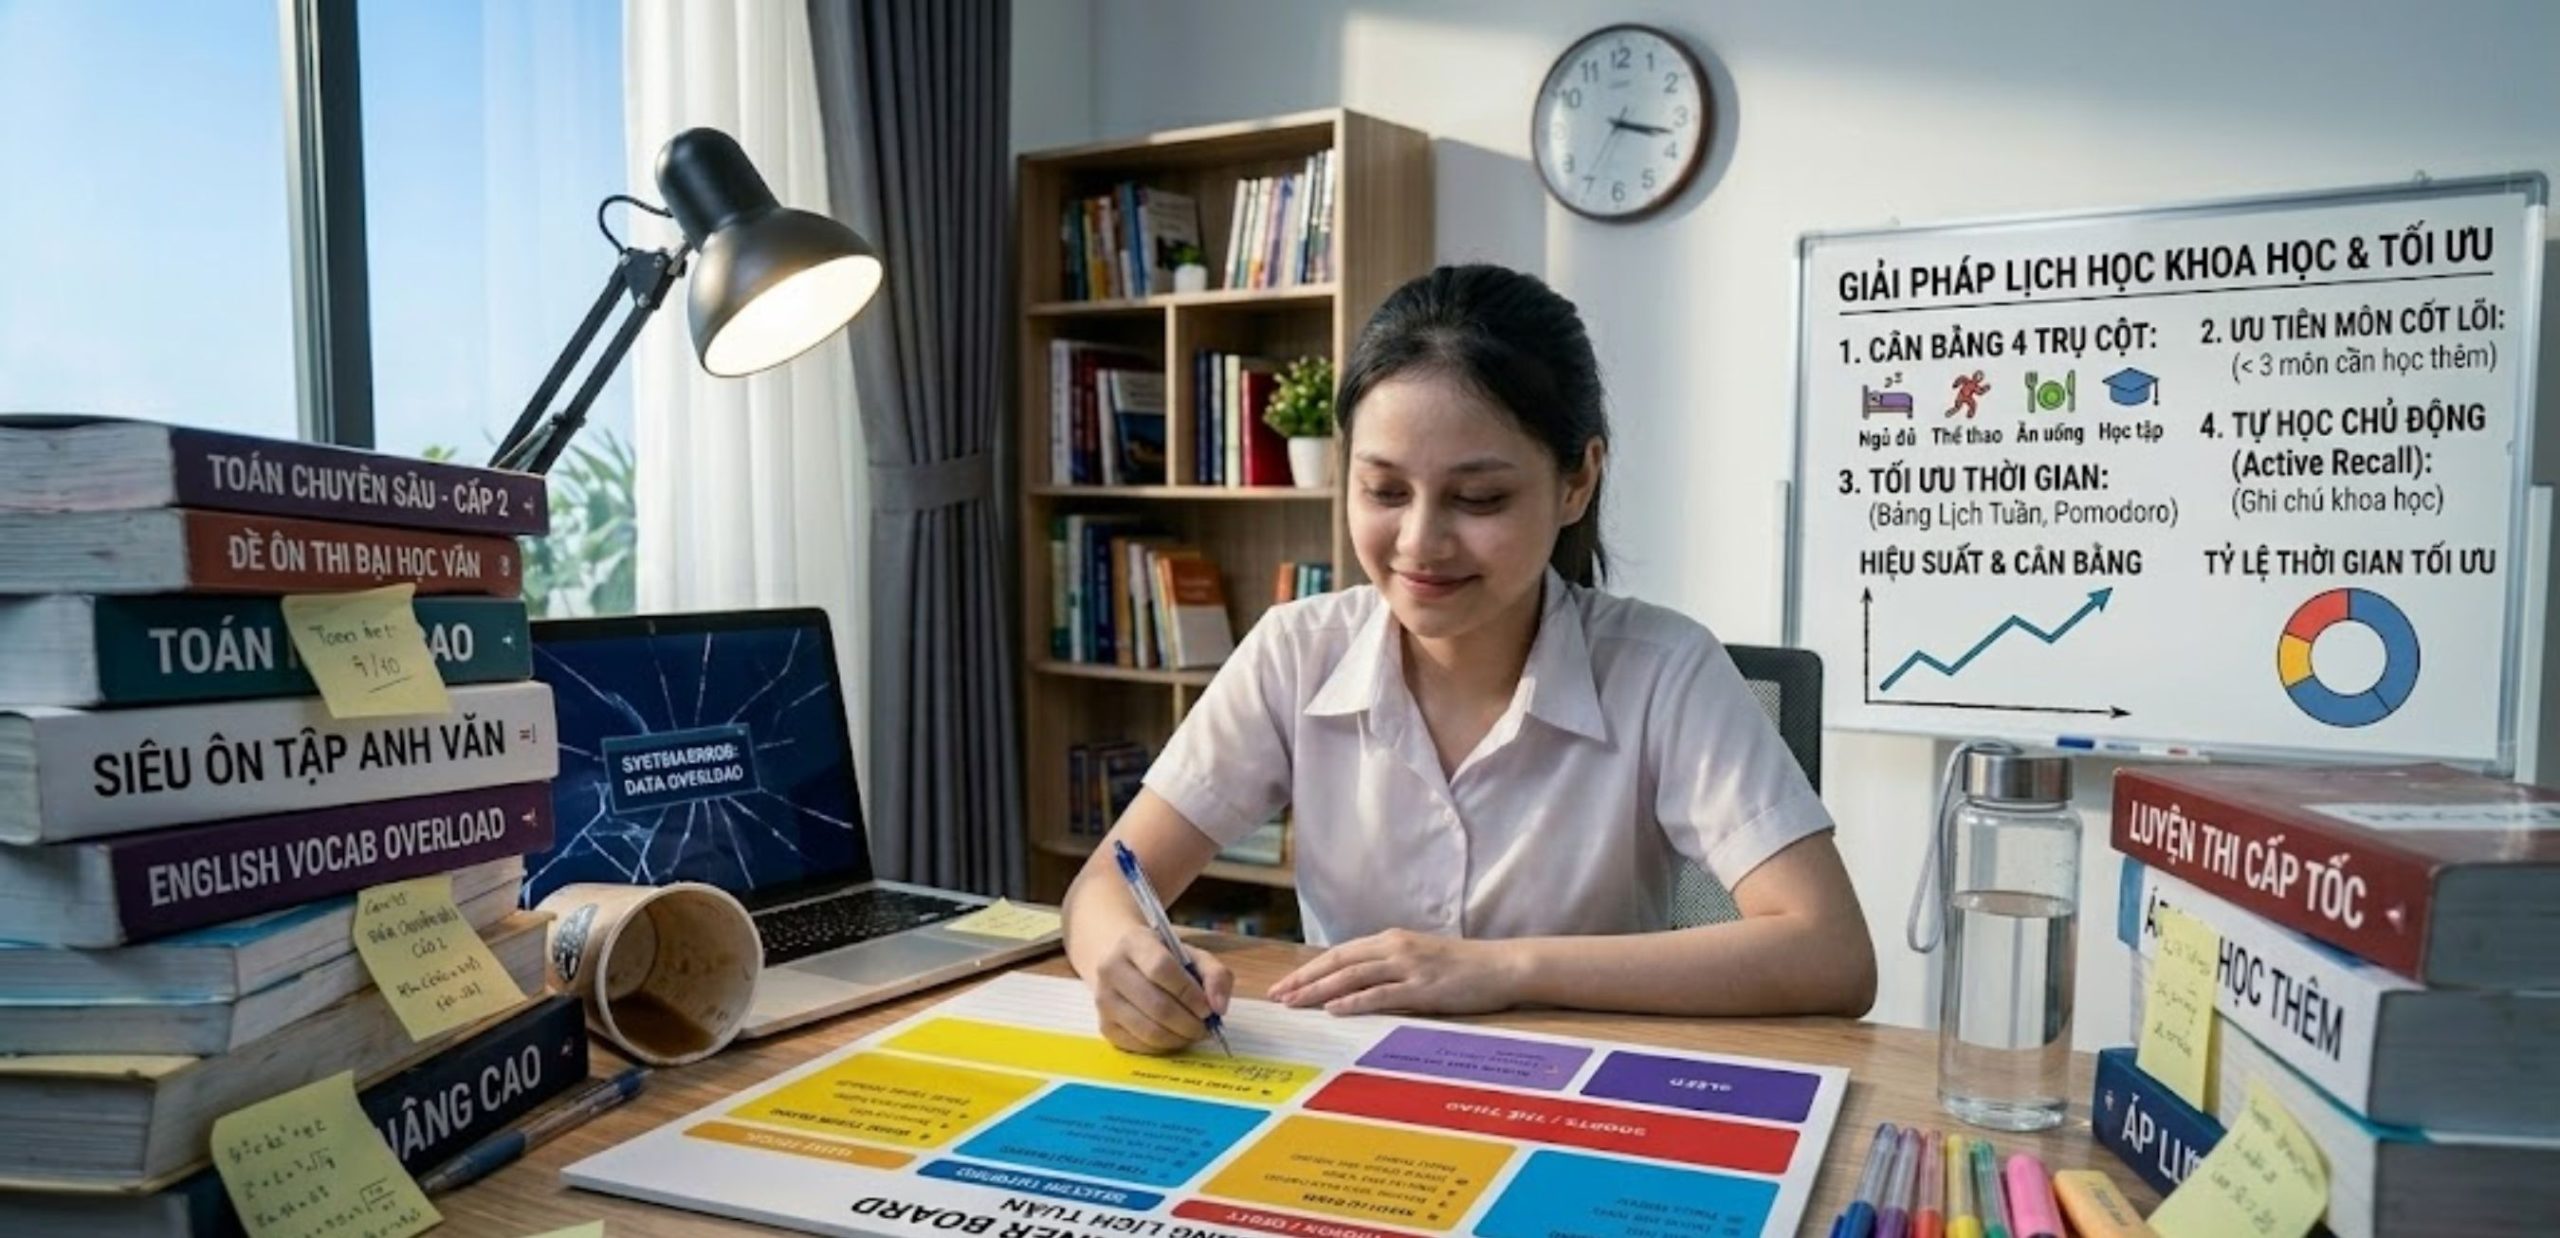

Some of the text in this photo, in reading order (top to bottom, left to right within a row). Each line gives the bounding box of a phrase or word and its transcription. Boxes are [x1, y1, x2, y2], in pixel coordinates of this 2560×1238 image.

[1581, 60, 1599, 83] 11
[1610, 48, 1631, 69] 12
[1646, 51, 1655, 71] 1
[1664, 72, 1679, 94] 2
[1674, 106, 1688, 128] 3
[1663, 141, 1678, 159] 4
[1582, 176, 1596, 194] 7
[1612, 181, 1625, 201] 6
[1641, 169, 1655, 189] 5
[1838, 220, 2494, 302] GIẢI PHÁP LỊCH HỌC KHOA HỌC & TỐI ƯU
[2201, 319, 2222, 344] 2.
[2230, 315, 2264, 342] ƯU
[2271, 307, 2326, 340] TIÊN
[2335, 304, 2393, 338] MÔN
[2401, 297, 2451, 334] CỐT
[1839, 338, 1861, 365] 1.
[2012, 329, 2027, 356] 4
[2035, 326, 2087, 359] TRỤ
[2095, 317, 2158, 357] CỘT:
[2259, 352, 2274, 377] 3
[2382, 347, 2424, 376] học
[2199, 397, 2486, 444] 4. TỰ HỌC CHỦ ĐỘNG
[207, 451, 285, 496] TOÁN
[498, 489, 510, 517] 2
[1838, 459, 2109, 495] 3. TỐI ƯU THỜI GIAN:
[2231, 444, 2433, 484] (Active Recall):
[1939, 499, 1984, 530] Lịch
[2054, 497, 2179, 528] Pomodoro)
[2231, 483, 2444, 520] (Ghi chú khoa học)
[270, 529, 306, 573] ÔN
[310, 540, 350, 574] THI
[398, 546, 439, 582] HỌC
[1860, 545, 1916, 582] HIỆU
[1922, 542, 1984, 575] SUẤT
[1991, 550, 2006, 575] &
[2243, 545, 2270, 583] LỆ
[2277, 543, 2335, 575] THỜI
[2343, 548, 2403, 575] GIAN
[2411, 540, 2451, 575] TỐI
[2460, 548, 2497, 575] ƯU
[148, 616, 274, 675] TOÁN
[429, 622, 474, 663] AO
[93, 713, 507, 798] SIÊU ÔN TẬP ANH VĂN
[625, 775, 666, 796] DATA
[148, 807, 507, 908] ENGLISH VOCAB OVERLOAD
[2129, 800, 2368, 930] LUYỆN THI CẤP TỐC
[2217, 936, 2264, 1008] HỌC
[2271, 968, 2344, 1063] THÊM
[480, 1044, 541, 1112] CAO
[850, 1196, 997, 1237] BOARD
